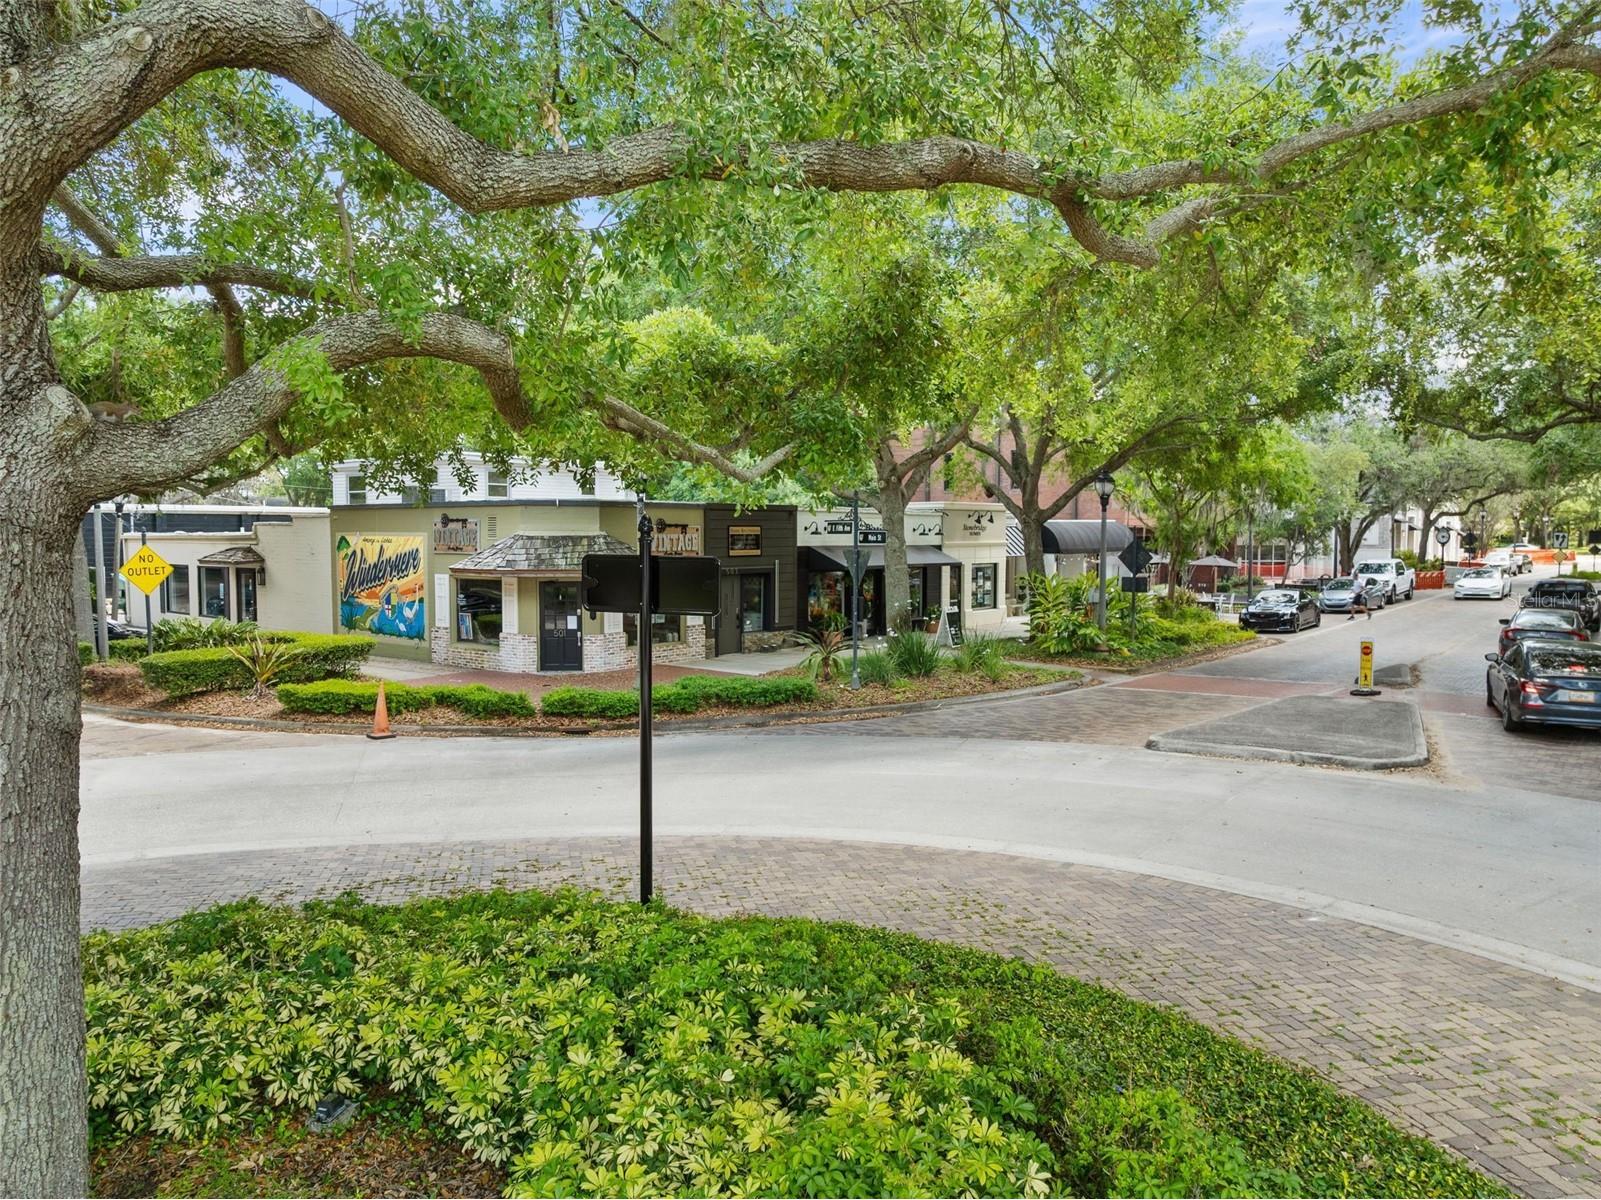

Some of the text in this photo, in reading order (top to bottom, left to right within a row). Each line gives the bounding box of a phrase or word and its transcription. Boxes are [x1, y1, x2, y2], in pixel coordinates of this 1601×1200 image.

[138, 554, 154, 564] NO
[127, 566, 166, 577] OUTLET
[342, 545, 421, 601] Windermere
